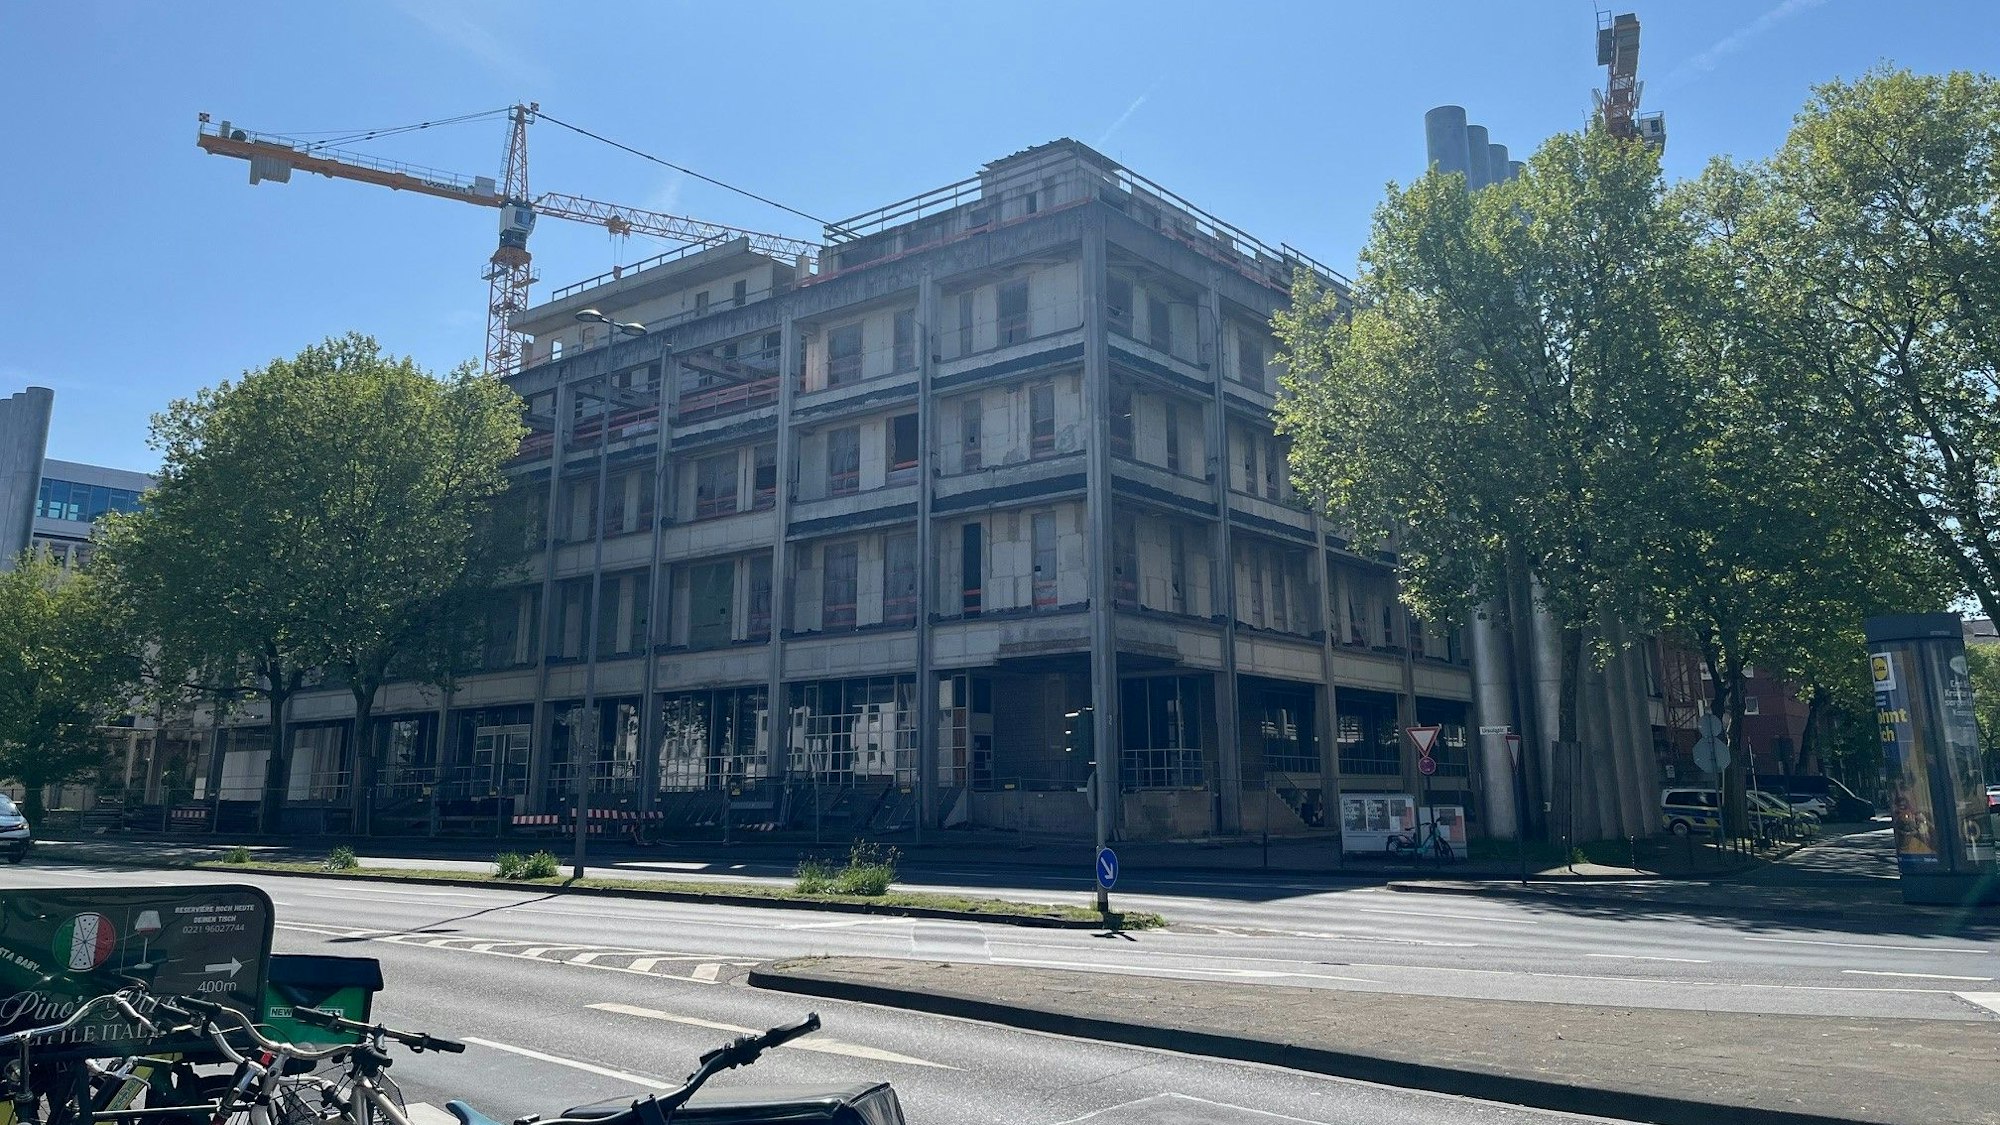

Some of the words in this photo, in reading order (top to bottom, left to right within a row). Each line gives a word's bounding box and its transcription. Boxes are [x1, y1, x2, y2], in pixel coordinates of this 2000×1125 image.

[215, 905, 233, 913] NOCH
[233, 904, 255, 912] HEUTE
[193, 916, 217, 924] DEINEN
[182, 925, 203, 934] 0221
[205, 924, 245, 933] 96027744
[197, 980, 237, 993] 400m
[0, 990, 86, 1027] Pino'
[271, 1007, 293, 1017] NEW
